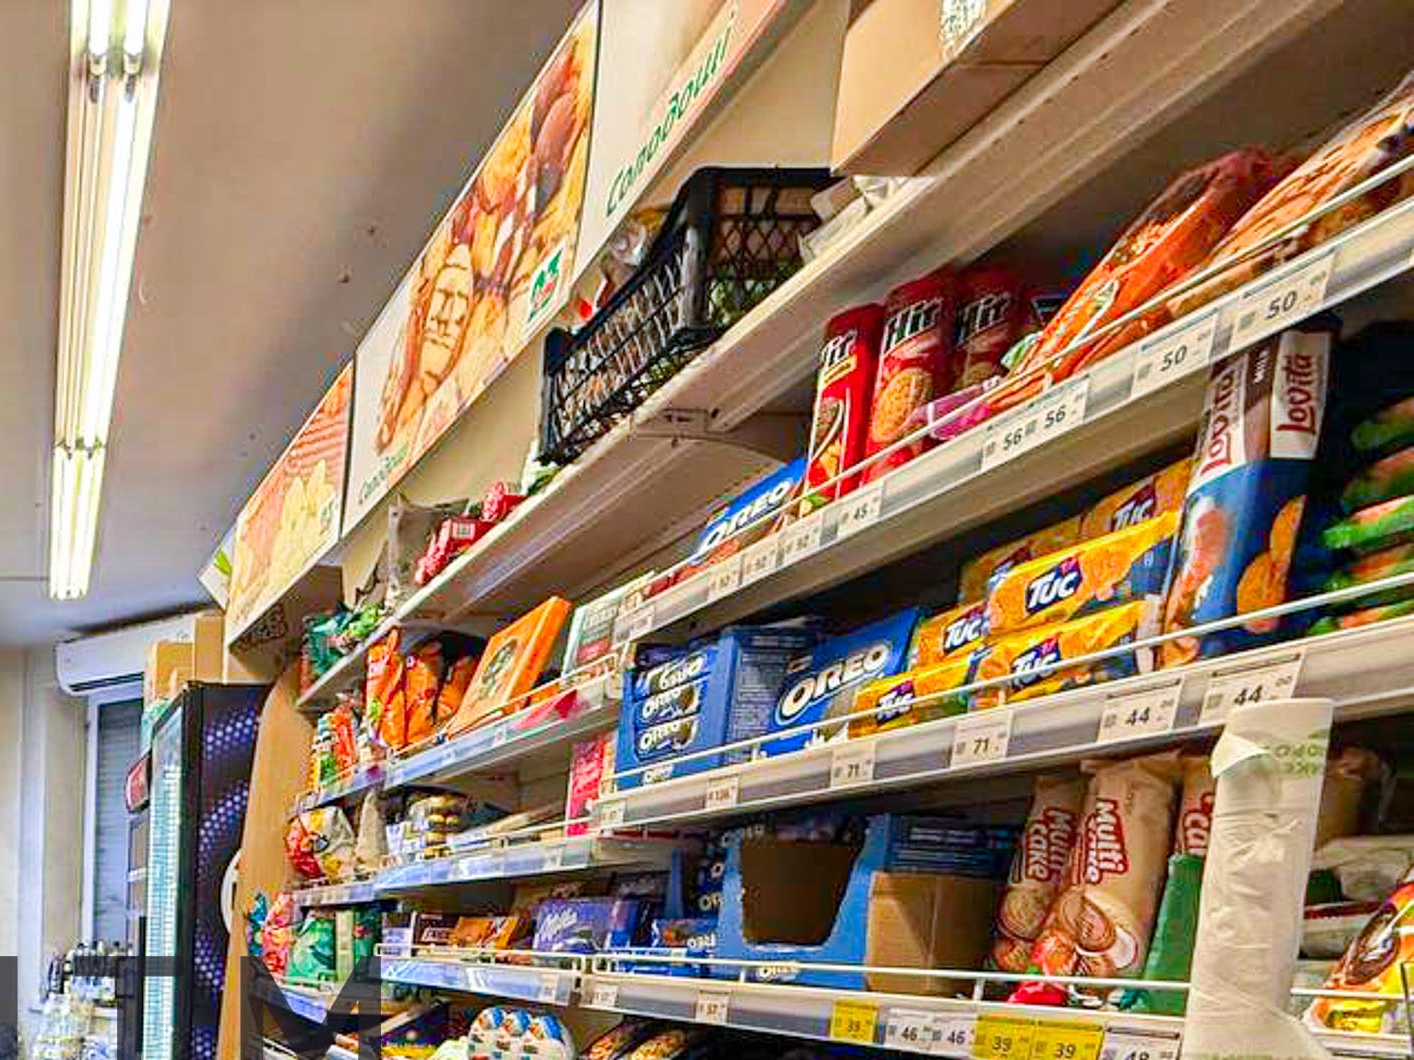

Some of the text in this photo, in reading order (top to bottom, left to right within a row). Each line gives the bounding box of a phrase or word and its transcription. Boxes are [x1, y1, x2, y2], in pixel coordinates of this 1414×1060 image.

[1267, 289, 1297, 321] 50
[1160, 346, 1188, 373] 50
[1045, 406, 1067, 429] 56
[1001, 429, 1023, 452] 56
[1026, 568, 1081, 611] TUC
[782, 647, 889, 716] OREO
[1232, 682, 1262, 705] 44
[1124, 707, 1150, 726] 44
[973, 739, 990, 757] 71
[1095, 800, 1126, 873] Multi
[901, 1027, 918, 1042] 46
[947, 1030, 966, 1045] 46
